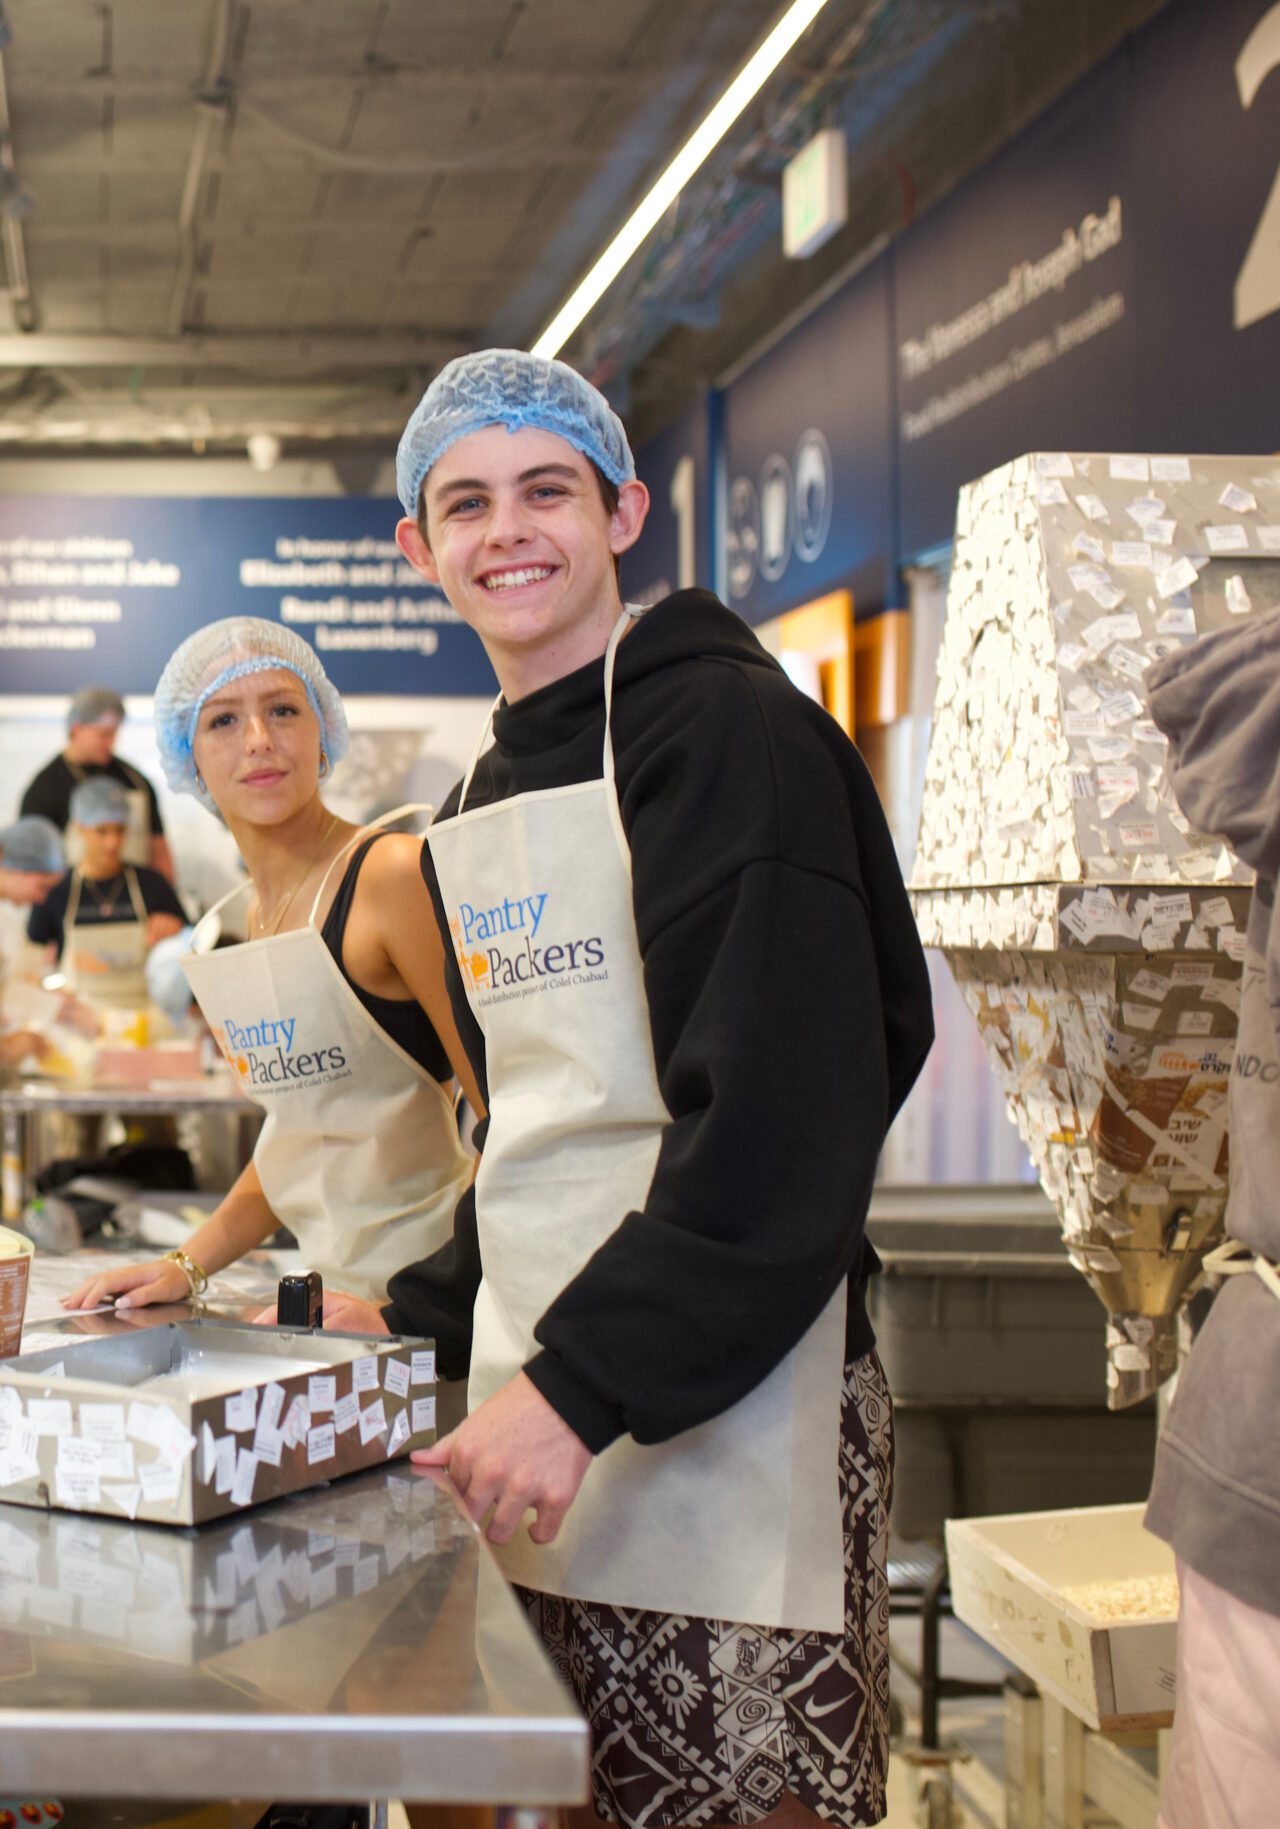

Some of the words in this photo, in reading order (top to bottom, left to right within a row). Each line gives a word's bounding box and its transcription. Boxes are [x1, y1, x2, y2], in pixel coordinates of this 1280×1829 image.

[459, 893, 549, 944] Pantry
[487, 935, 605, 989] Packers
[540, 980, 548, 991] of
[549, 976, 571, 989] Colel
[572, 969, 609, 985] Chabad
[224, 1018, 296, 1053] Pantry
[247, 1046, 346, 1084] Packers
